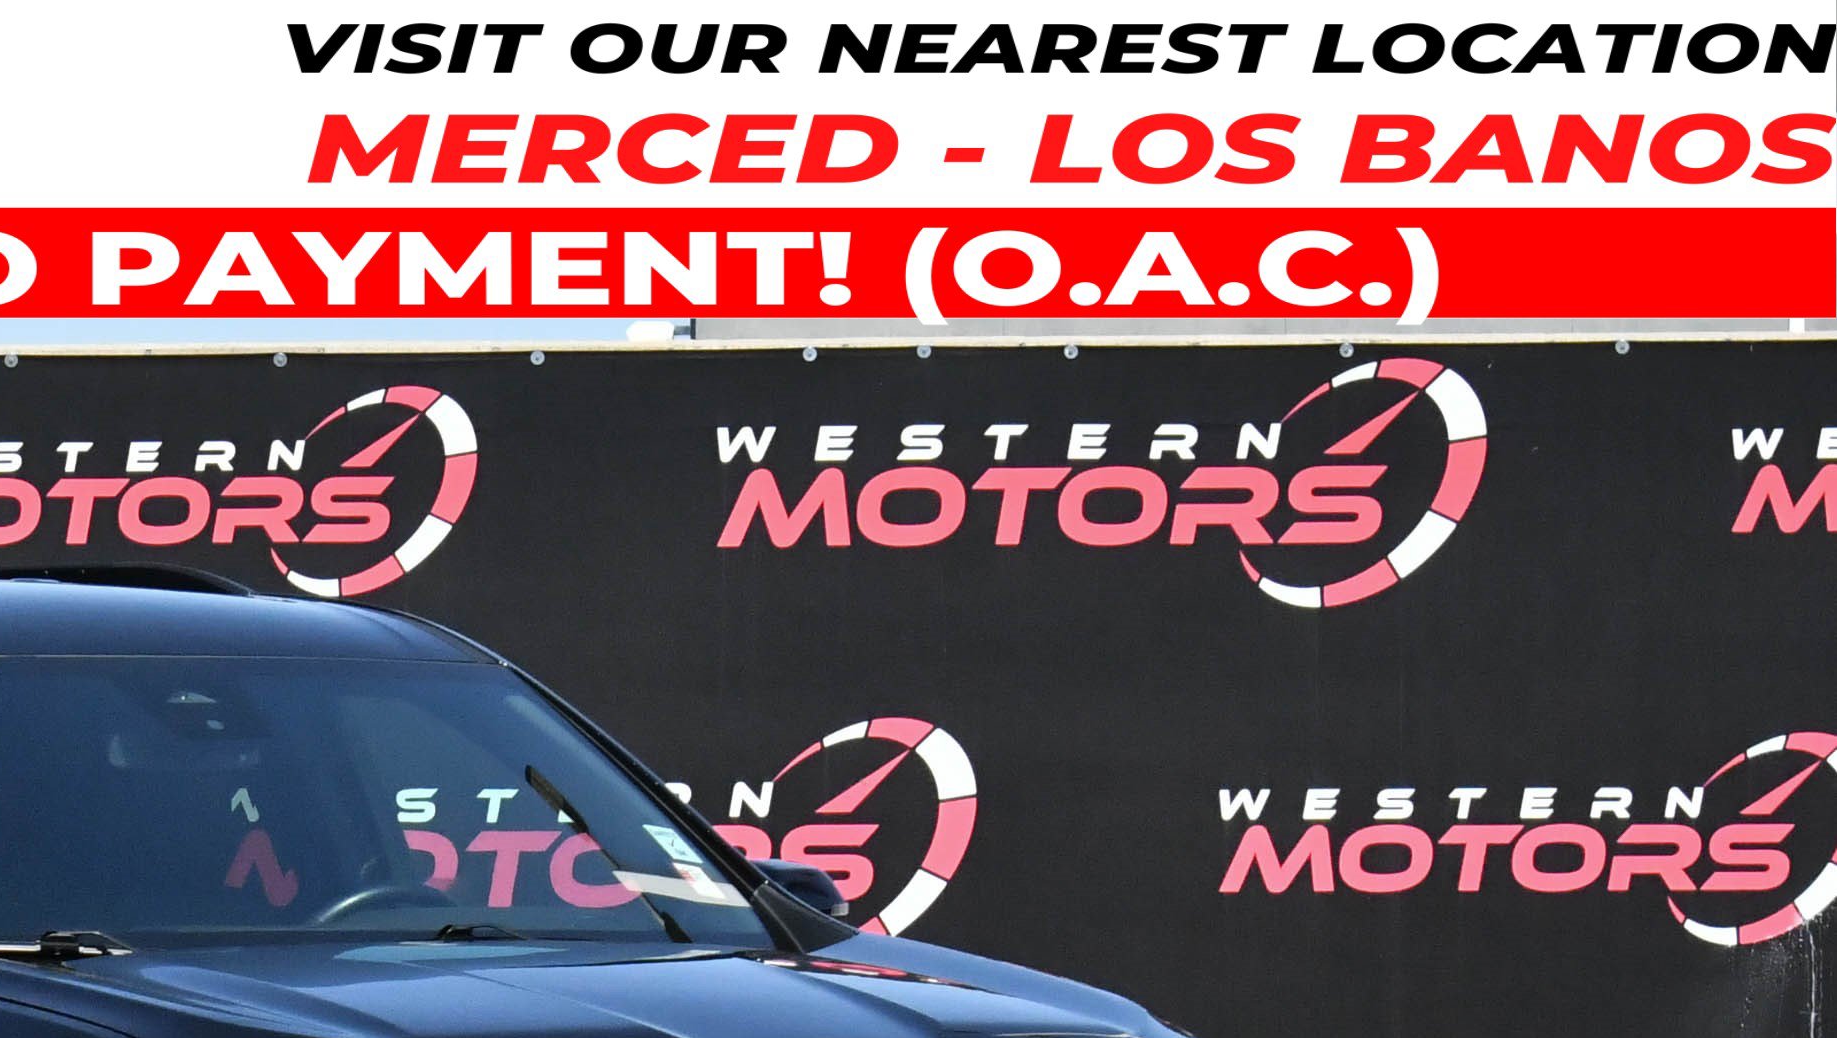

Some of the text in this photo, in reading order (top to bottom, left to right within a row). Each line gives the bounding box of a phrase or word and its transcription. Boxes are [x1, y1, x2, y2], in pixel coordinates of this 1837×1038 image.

[716, 422, 1282, 463] WESTERN
[717, 464, 1388, 549] MOTORS
[1218, 786, 1705, 821] WESTERN
[1219, 822, 1795, 894] MOTORS
